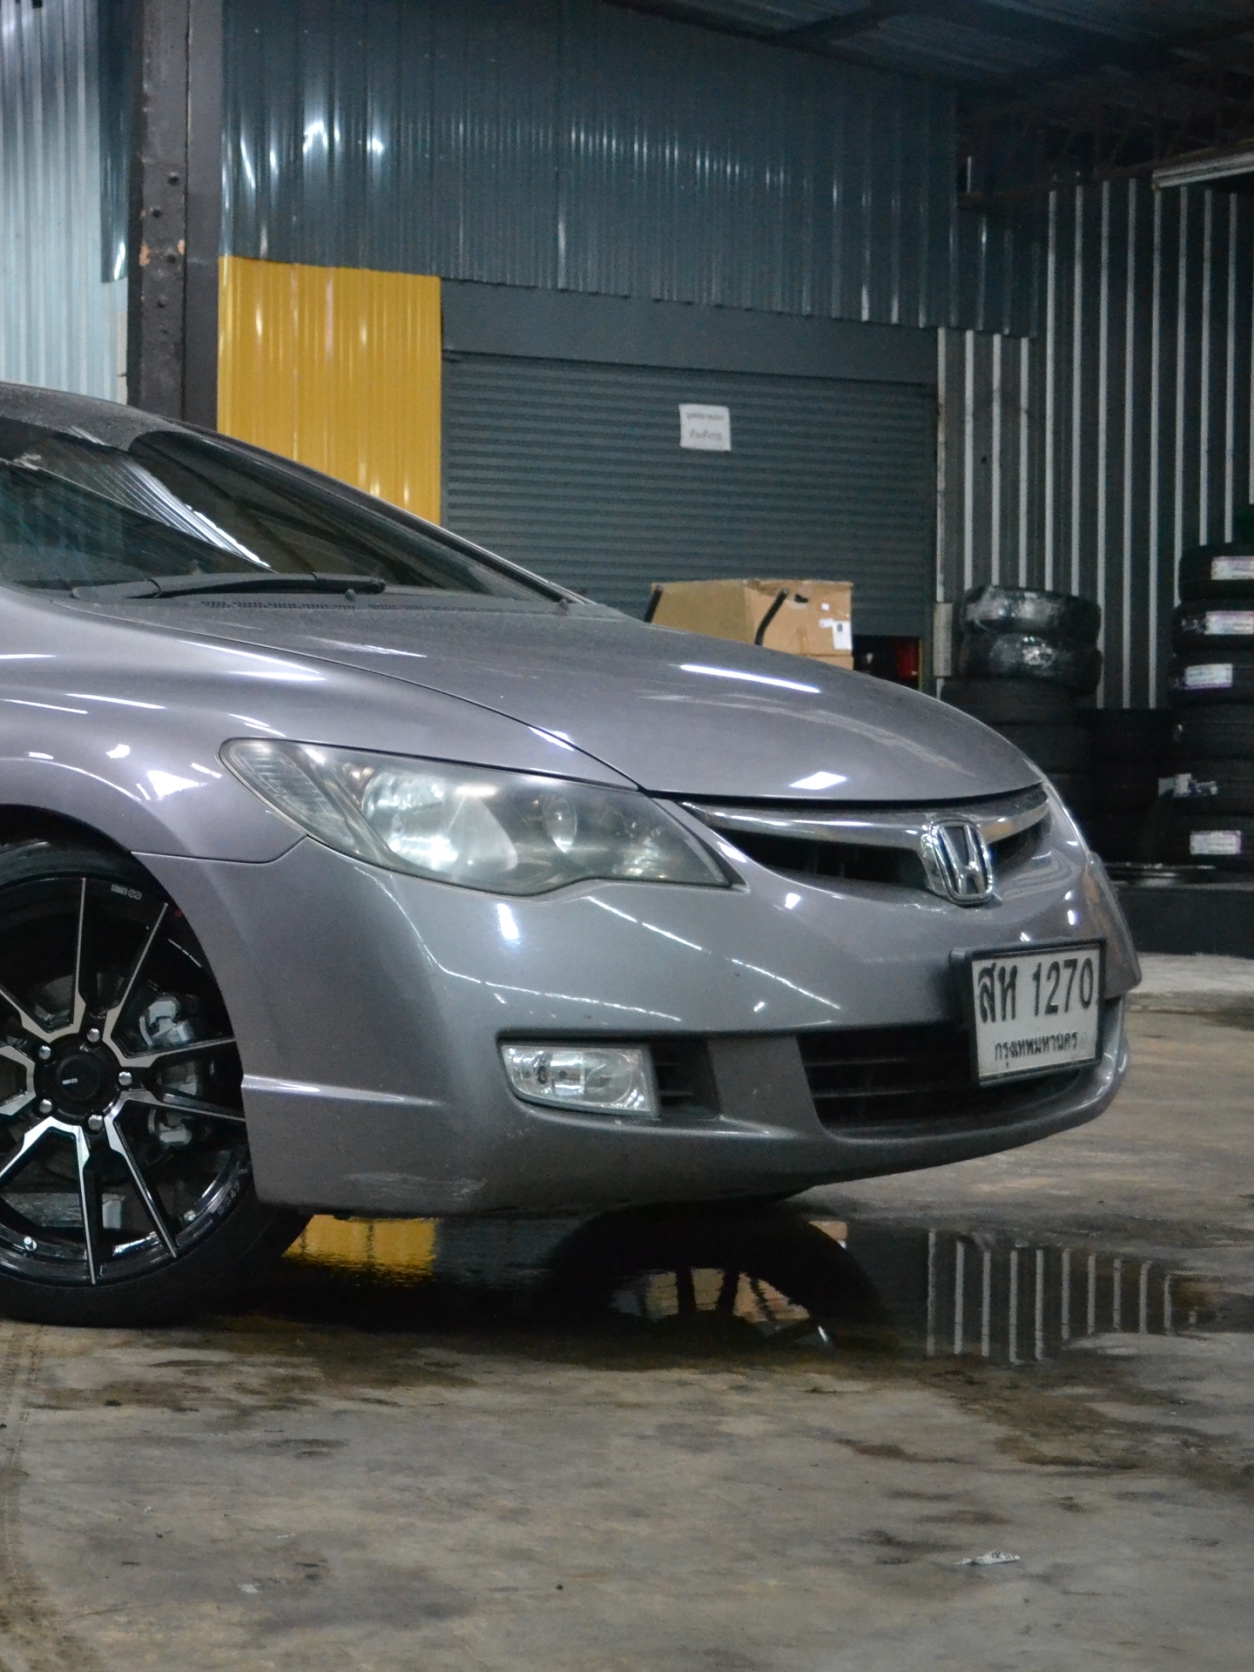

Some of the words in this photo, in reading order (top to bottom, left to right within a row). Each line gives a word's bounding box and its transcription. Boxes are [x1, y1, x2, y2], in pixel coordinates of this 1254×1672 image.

[1032, 957, 1094, 1016] 1270
[994, 1032, 1078, 1068] กรุงเทพมหานคร
